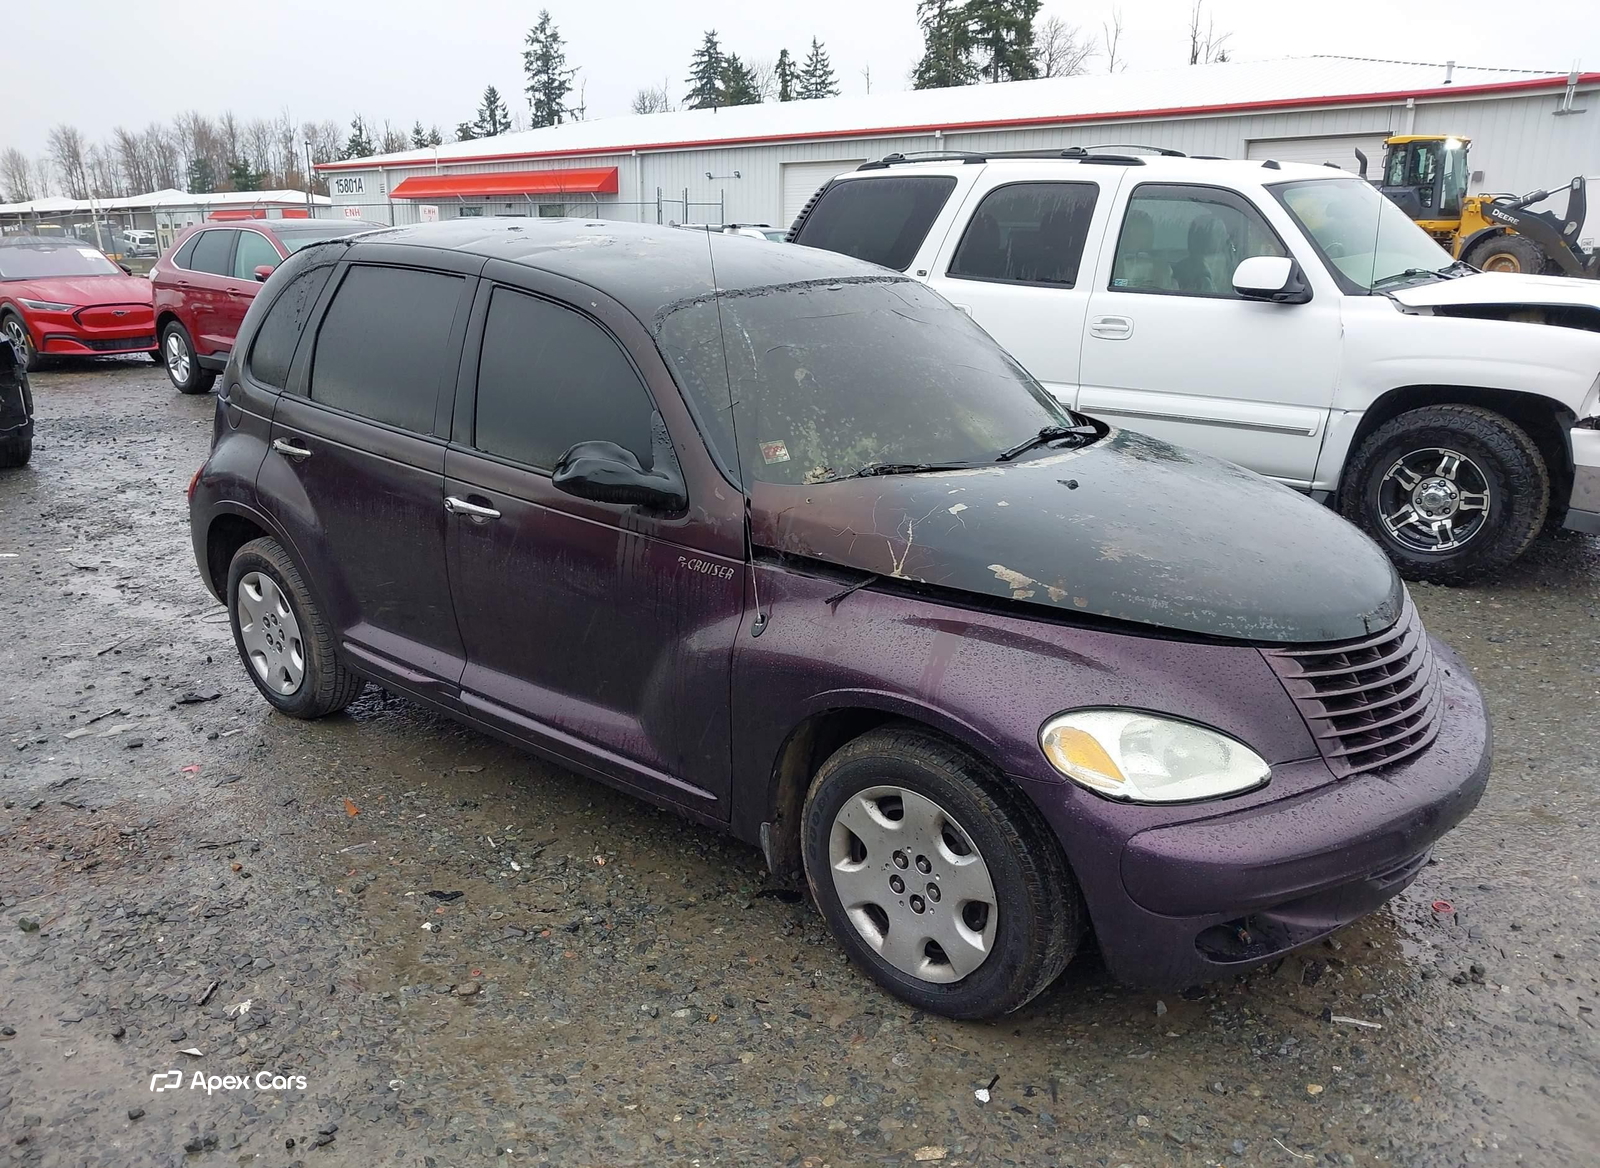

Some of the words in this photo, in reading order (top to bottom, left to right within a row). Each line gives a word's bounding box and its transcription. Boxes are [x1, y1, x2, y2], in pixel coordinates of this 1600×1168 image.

[335, 177, 364, 194] 15801A
[344, 208, 361, 217] ENH
[1491, 208, 1520, 226] DEERE
[687, 558, 735, 580] CRUISER
